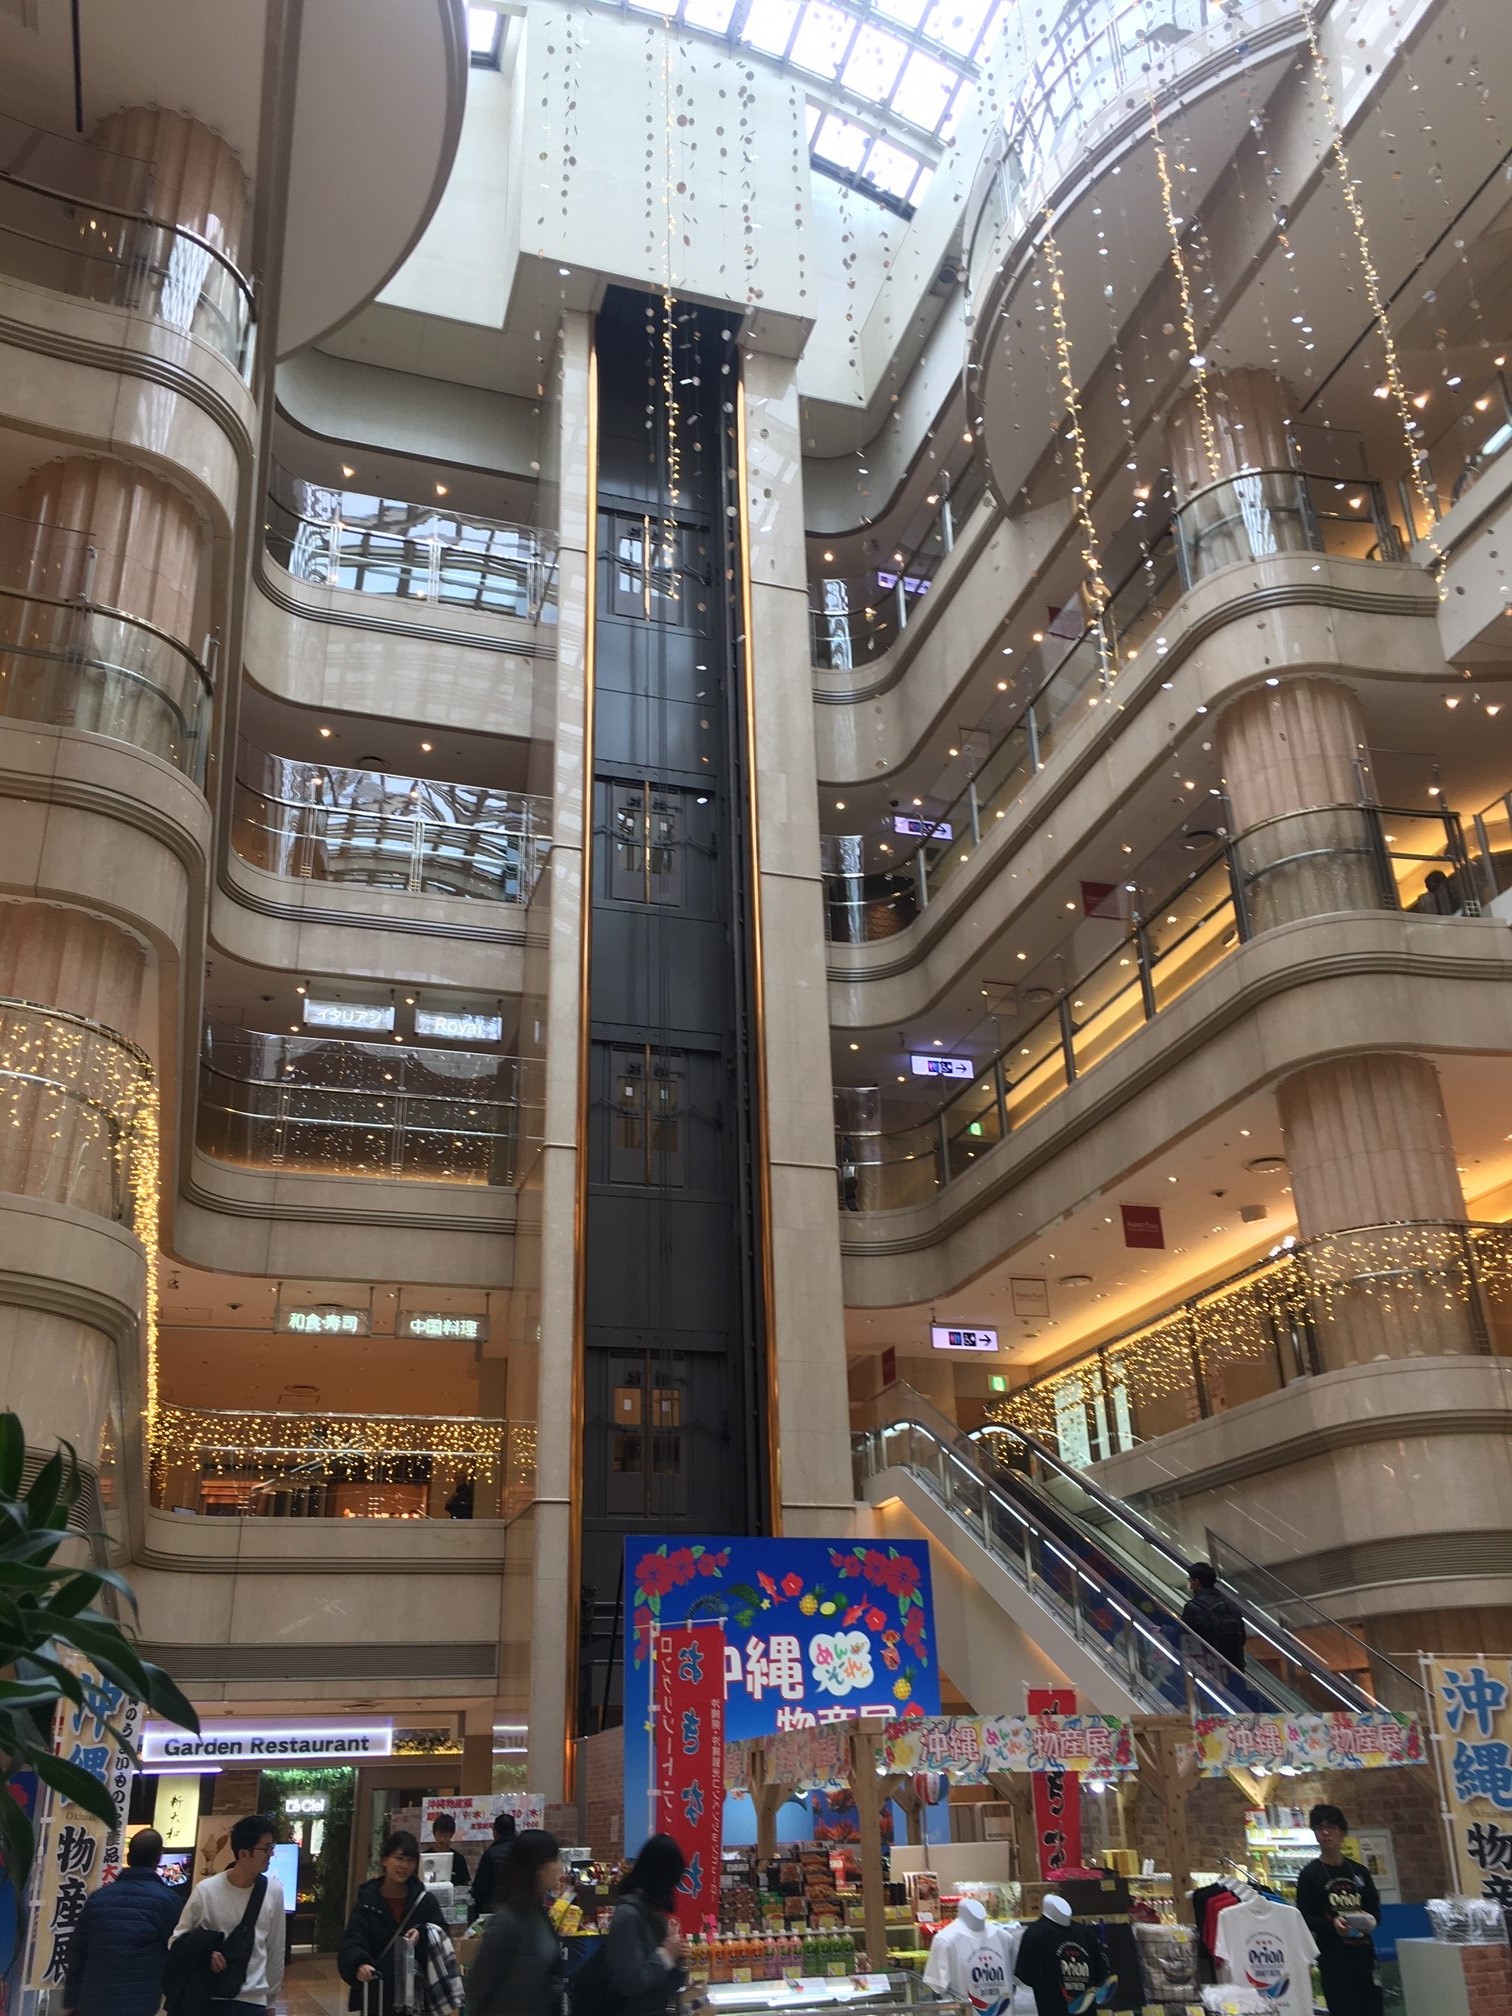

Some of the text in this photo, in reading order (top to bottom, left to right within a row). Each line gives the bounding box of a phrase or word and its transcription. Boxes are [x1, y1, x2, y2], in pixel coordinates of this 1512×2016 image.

[318, 1008, 383, 1024] イタリアン
[435, 1017, 482, 1035] Royal
[288, 1312, 358, 1332] 和食・寿司
[410, 1318, 479, 1337] 中国料理
[164, 1736, 369, 1756] Garden Restaurant
[920, 1726, 980, 1761] 沖縄
[1032, 1726, 1113, 1759] 物産展
[1228, 1722, 1284, 1757] 沖縄
[1331, 1723, 1403, 1754] 物産展
[1441, 1668, 1512, 1811] 沖縄
[301, 1798, 325, 1813] Ciel
